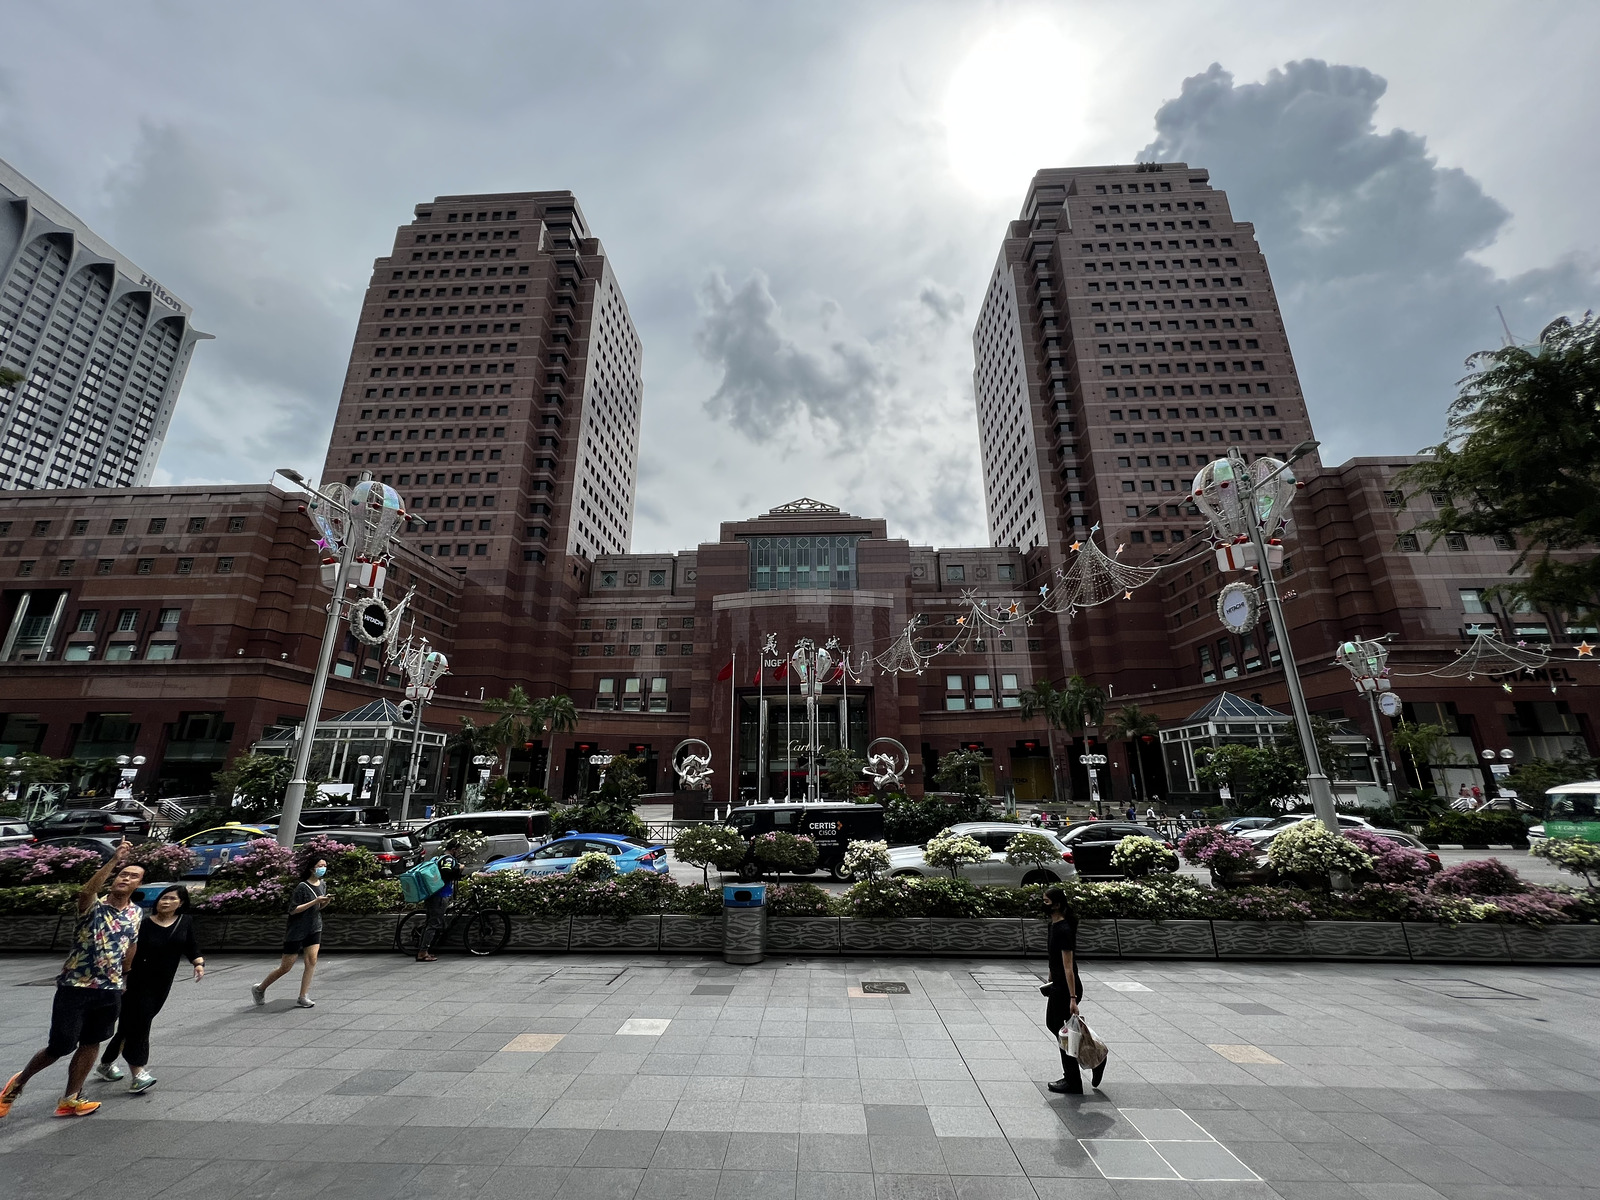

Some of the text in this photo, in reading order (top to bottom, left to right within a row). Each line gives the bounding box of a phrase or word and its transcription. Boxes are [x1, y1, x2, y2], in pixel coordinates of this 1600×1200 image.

[140, 274, 182, 311] Hilton
[1226, 601, 1245, 614] HITACHI
[364, 614, 383, 627] HITACHI
[764, 659, 788, 668] NGE
[1489, 667, 1577, 682] CHANEL
